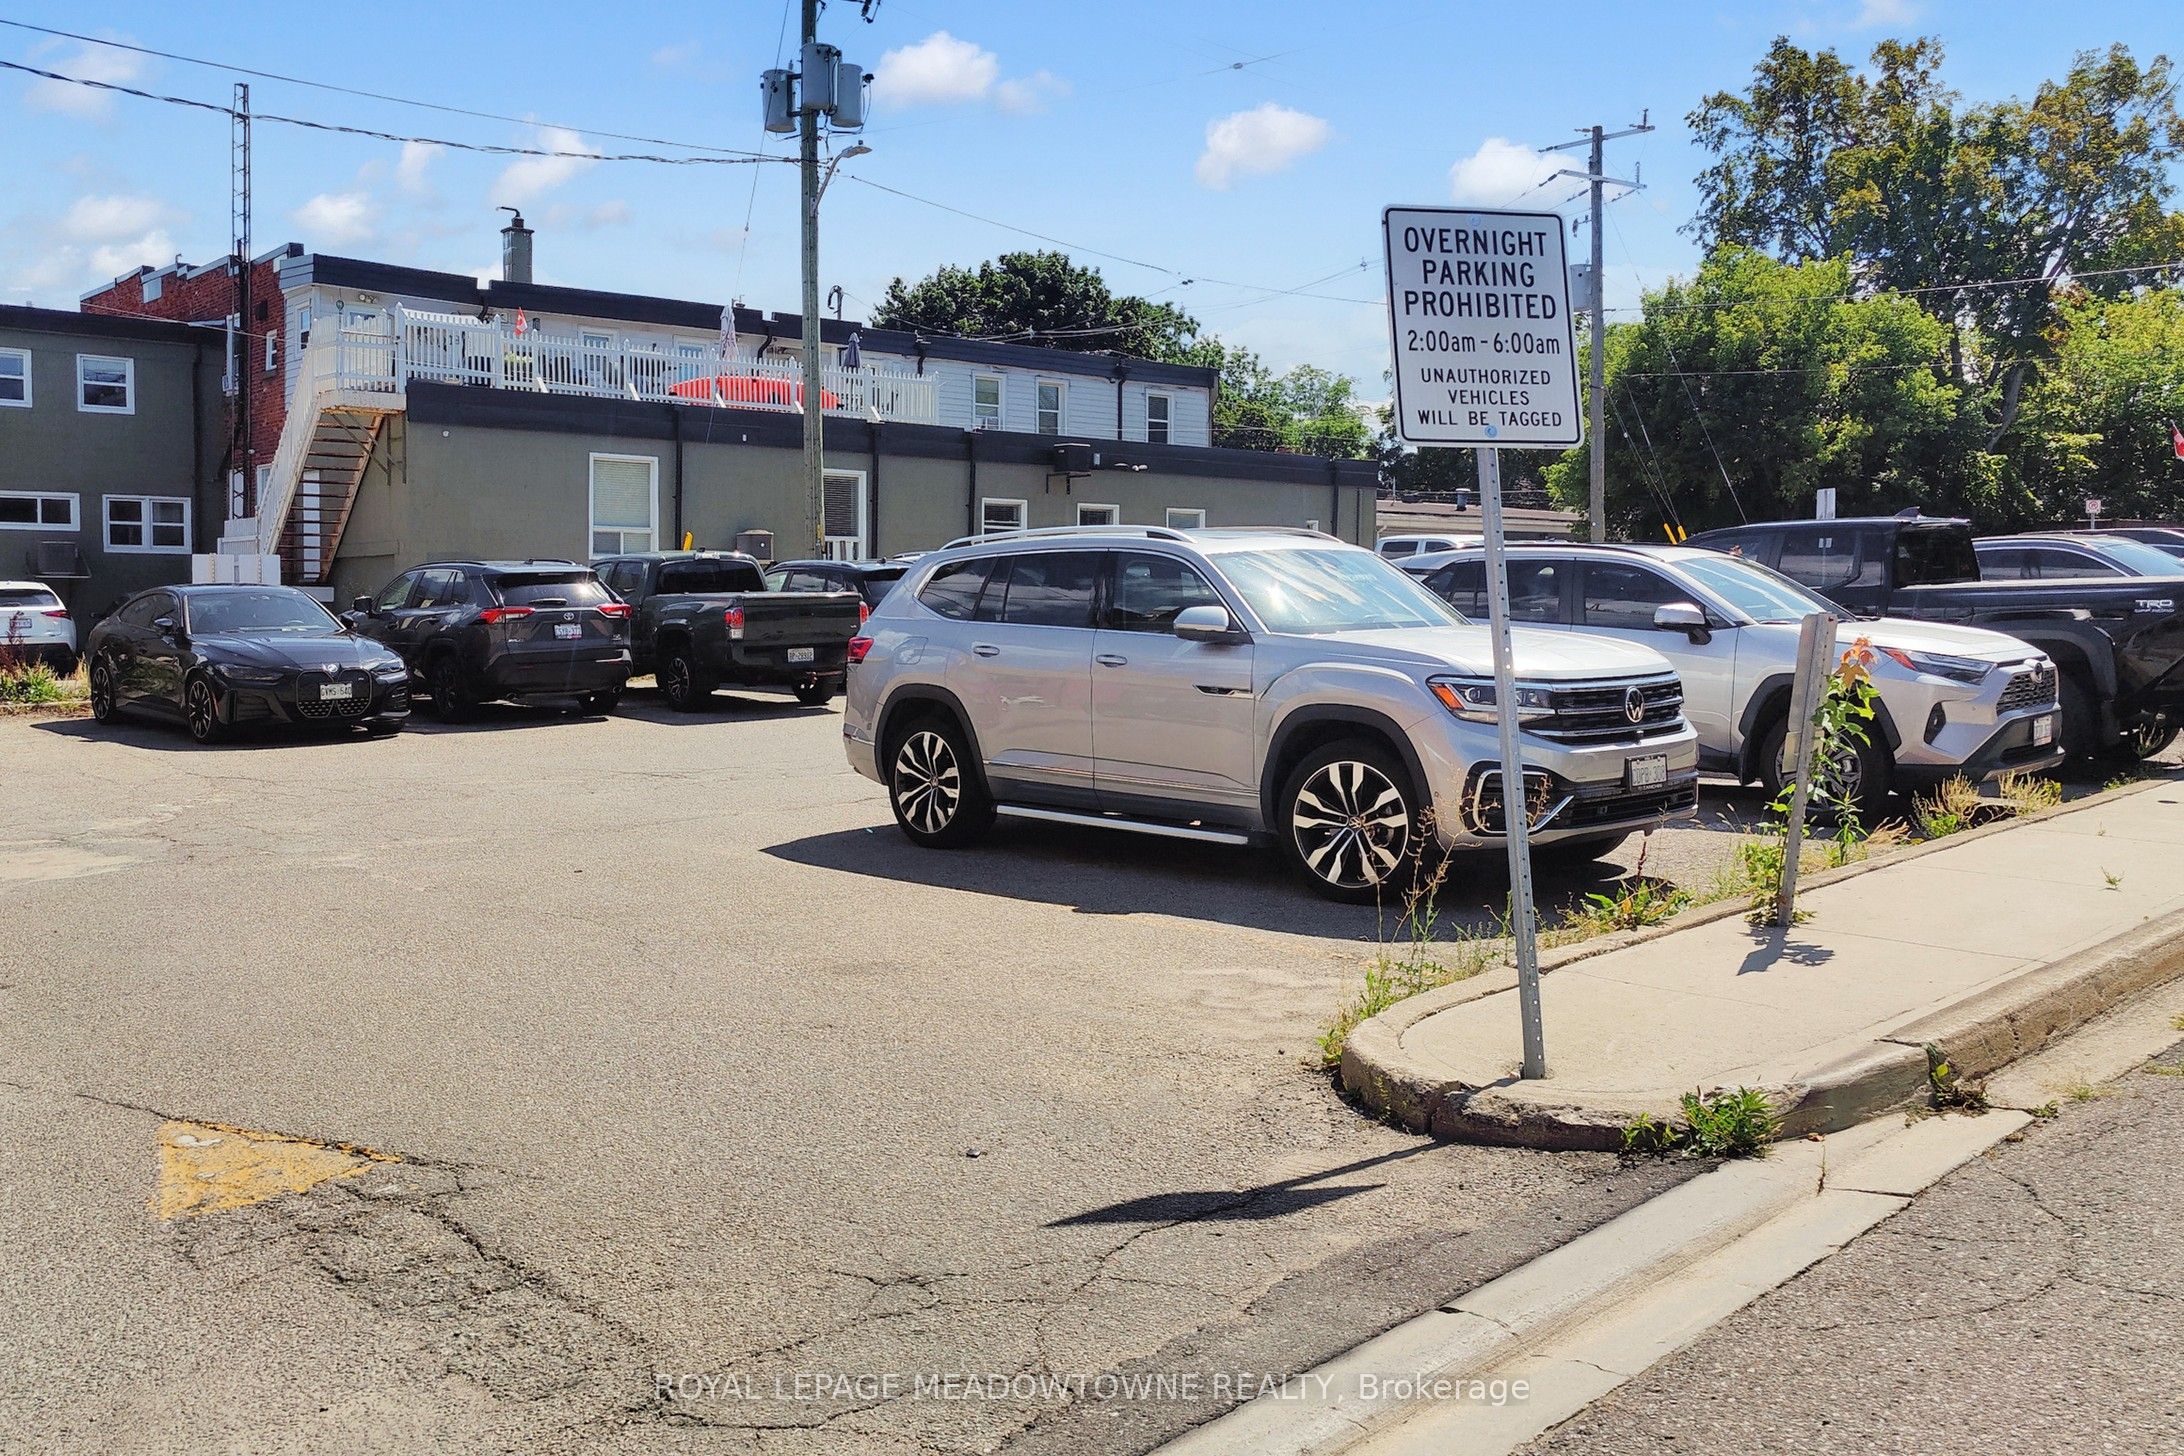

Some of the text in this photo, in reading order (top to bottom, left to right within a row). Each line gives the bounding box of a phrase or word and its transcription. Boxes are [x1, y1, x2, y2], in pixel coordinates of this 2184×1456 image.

[1404, 227, 1547, 257] OVERNIGHT
[1422, 260, 1535, 288] PARKING
[1404, 290, 1557, 320] PROHIBITED
[1420, 368, 1551, 385] UNAUTHORIZED
[1447, 389, 1530, 406] VEHICLES
[1417, 409, 1562, 427] WILL BE TAGGED
